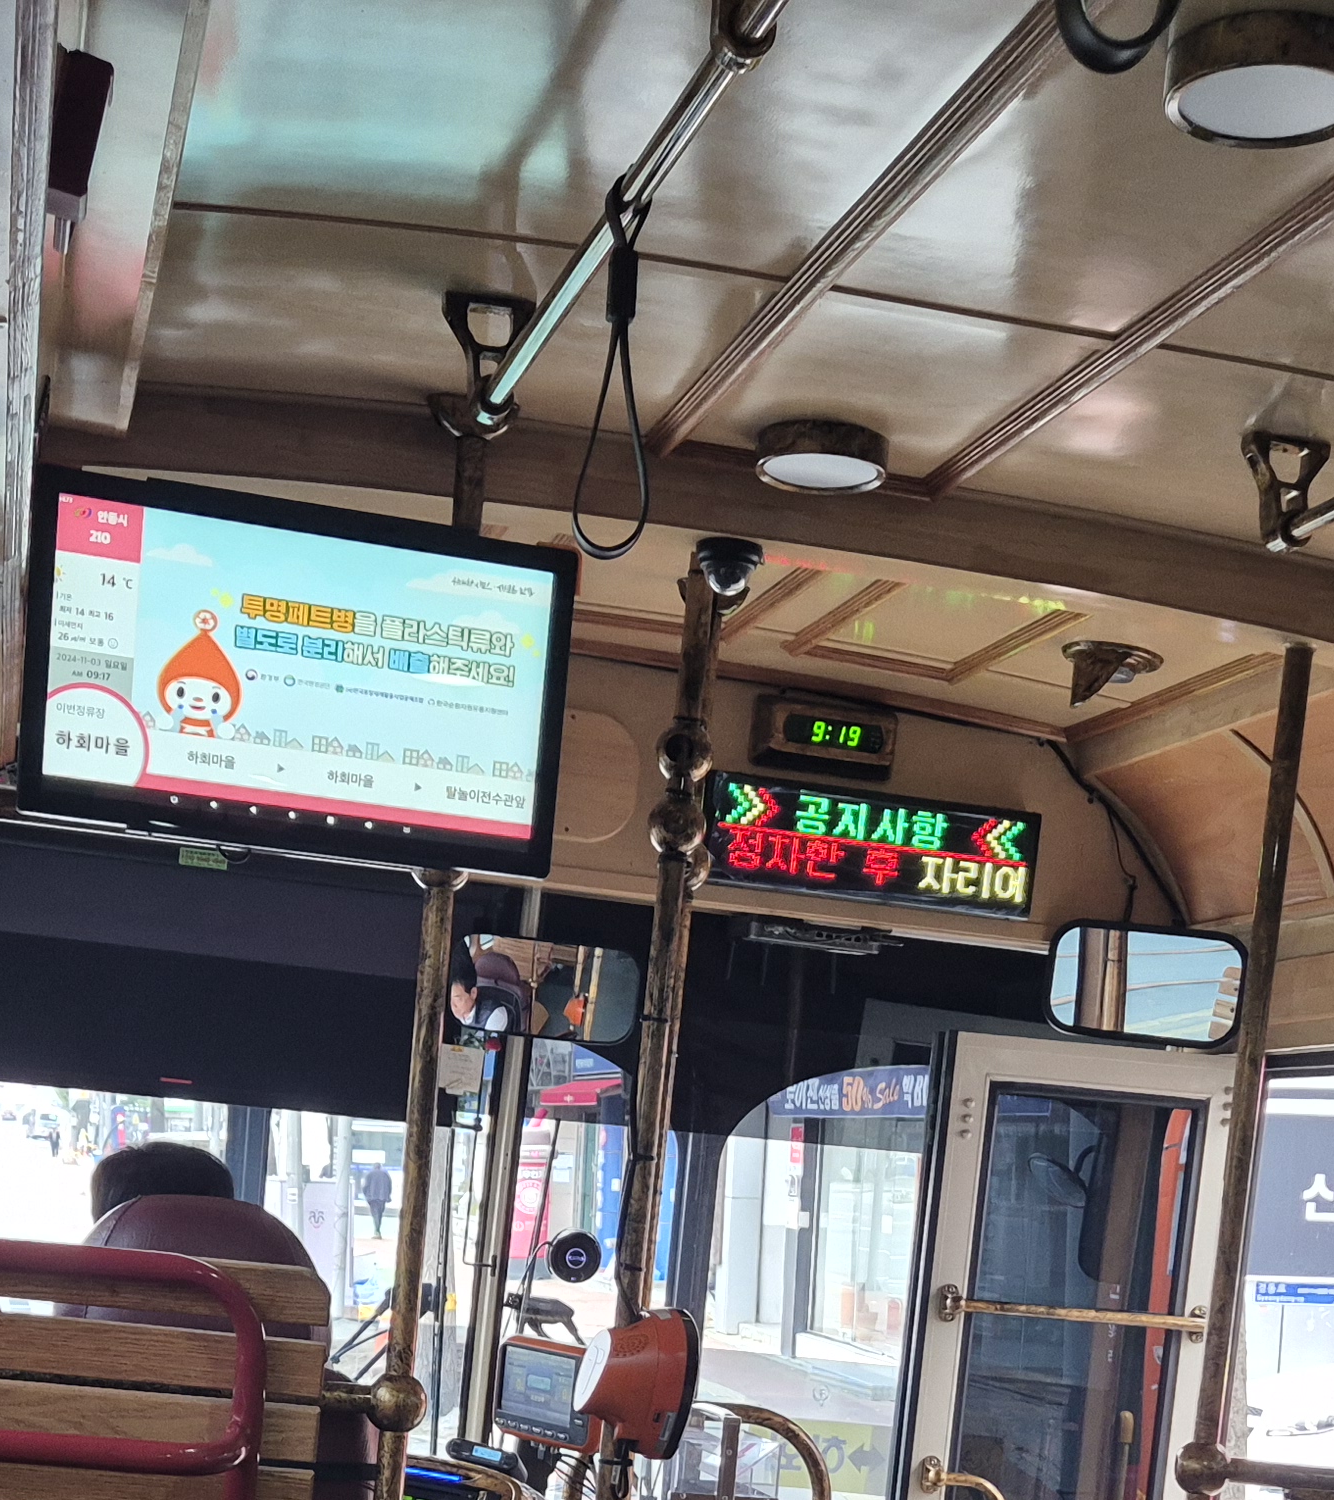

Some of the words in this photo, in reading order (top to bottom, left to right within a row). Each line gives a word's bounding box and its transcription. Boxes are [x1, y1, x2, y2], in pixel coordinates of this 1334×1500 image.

[89, 529, 111, 544] 210
[100, 572, 116, 588] 14
[75, 606, 85, 616] 14
[104, 611, 114, 621] 16
[240, 593, 377, 637] 투명페트병을
[381, 614, 515, 658] 플라스틱류와
[57, 631, 69, 641] 26
[56, 653, 101, 666] 2024-11-03
[104, 659, 128, 671] 일요일
[234, 624, 298, 656] 별도로
[301, 634, 385, 669] 분리해서
[388, 648, 515, 688] 배출해주세요!
[86, 670, 111, 681] 09:17
[55, 702, 105, 719] 이번정류장
[55, 730, 130, 757] 하회마을
[811, 720, 862, 748] 9:19
[186, 750, 236, 770] 하회마을
[326, 769, 375, 789] 하회마을
[445, 785, 526, 812] 탈놀이전수관앞
[795, 793, 950, 851] 공지사항
[861, 846, 901, 887] 후
[873, 1077, 901, 1110] Sale
